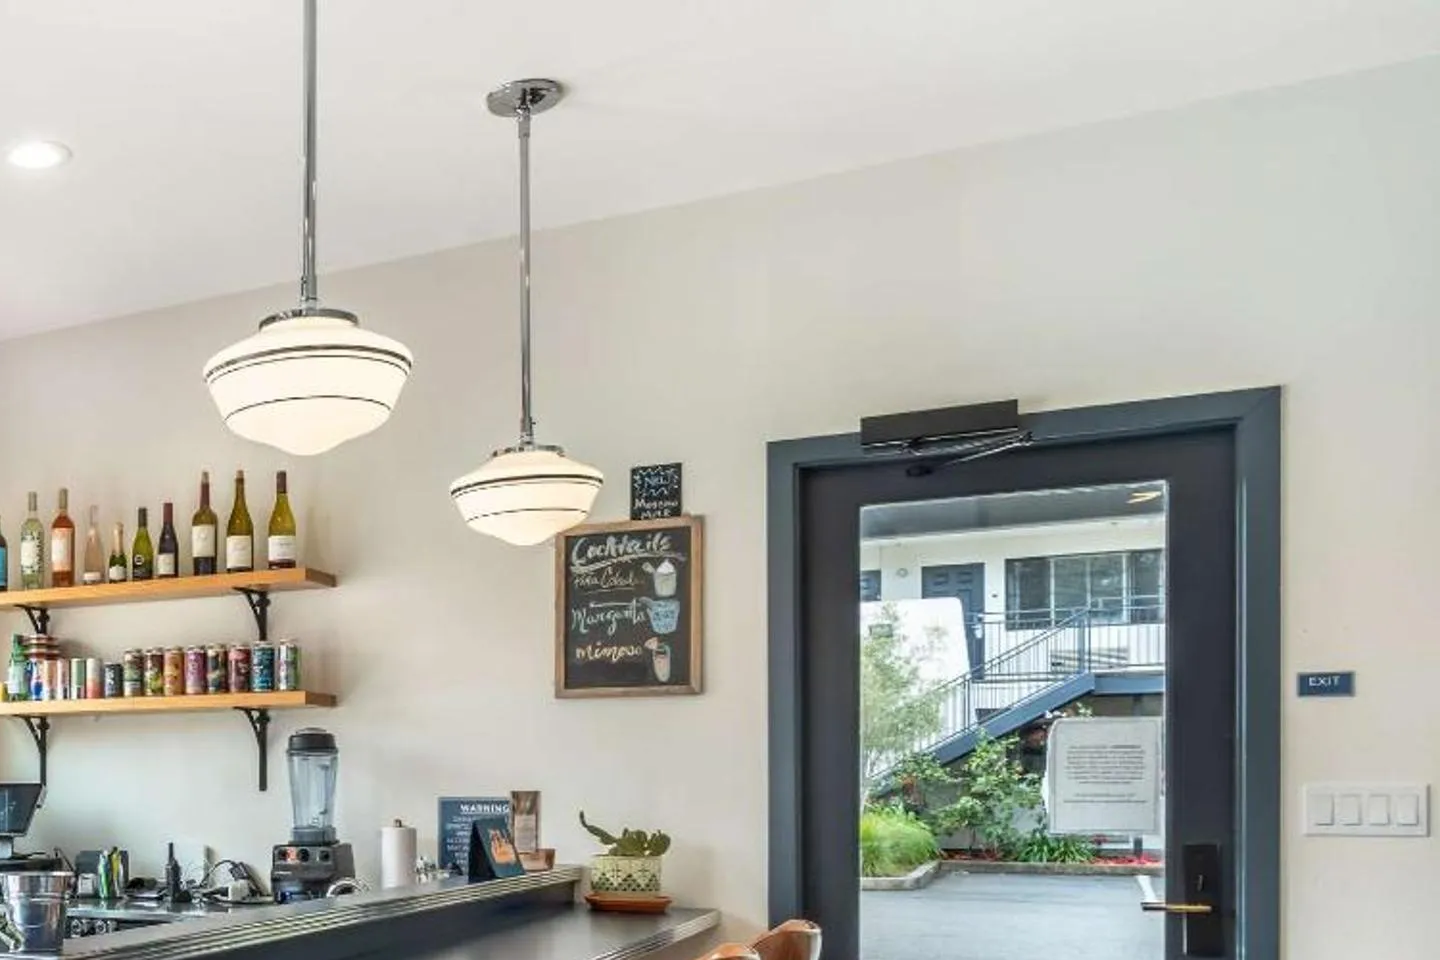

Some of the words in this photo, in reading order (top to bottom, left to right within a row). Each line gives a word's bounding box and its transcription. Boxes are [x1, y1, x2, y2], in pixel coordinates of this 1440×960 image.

[571, 532, 672, 567] Cocktails
[1308, 675, 1341, 687] EXIT
[460, 803, 510, 814] WARNING
